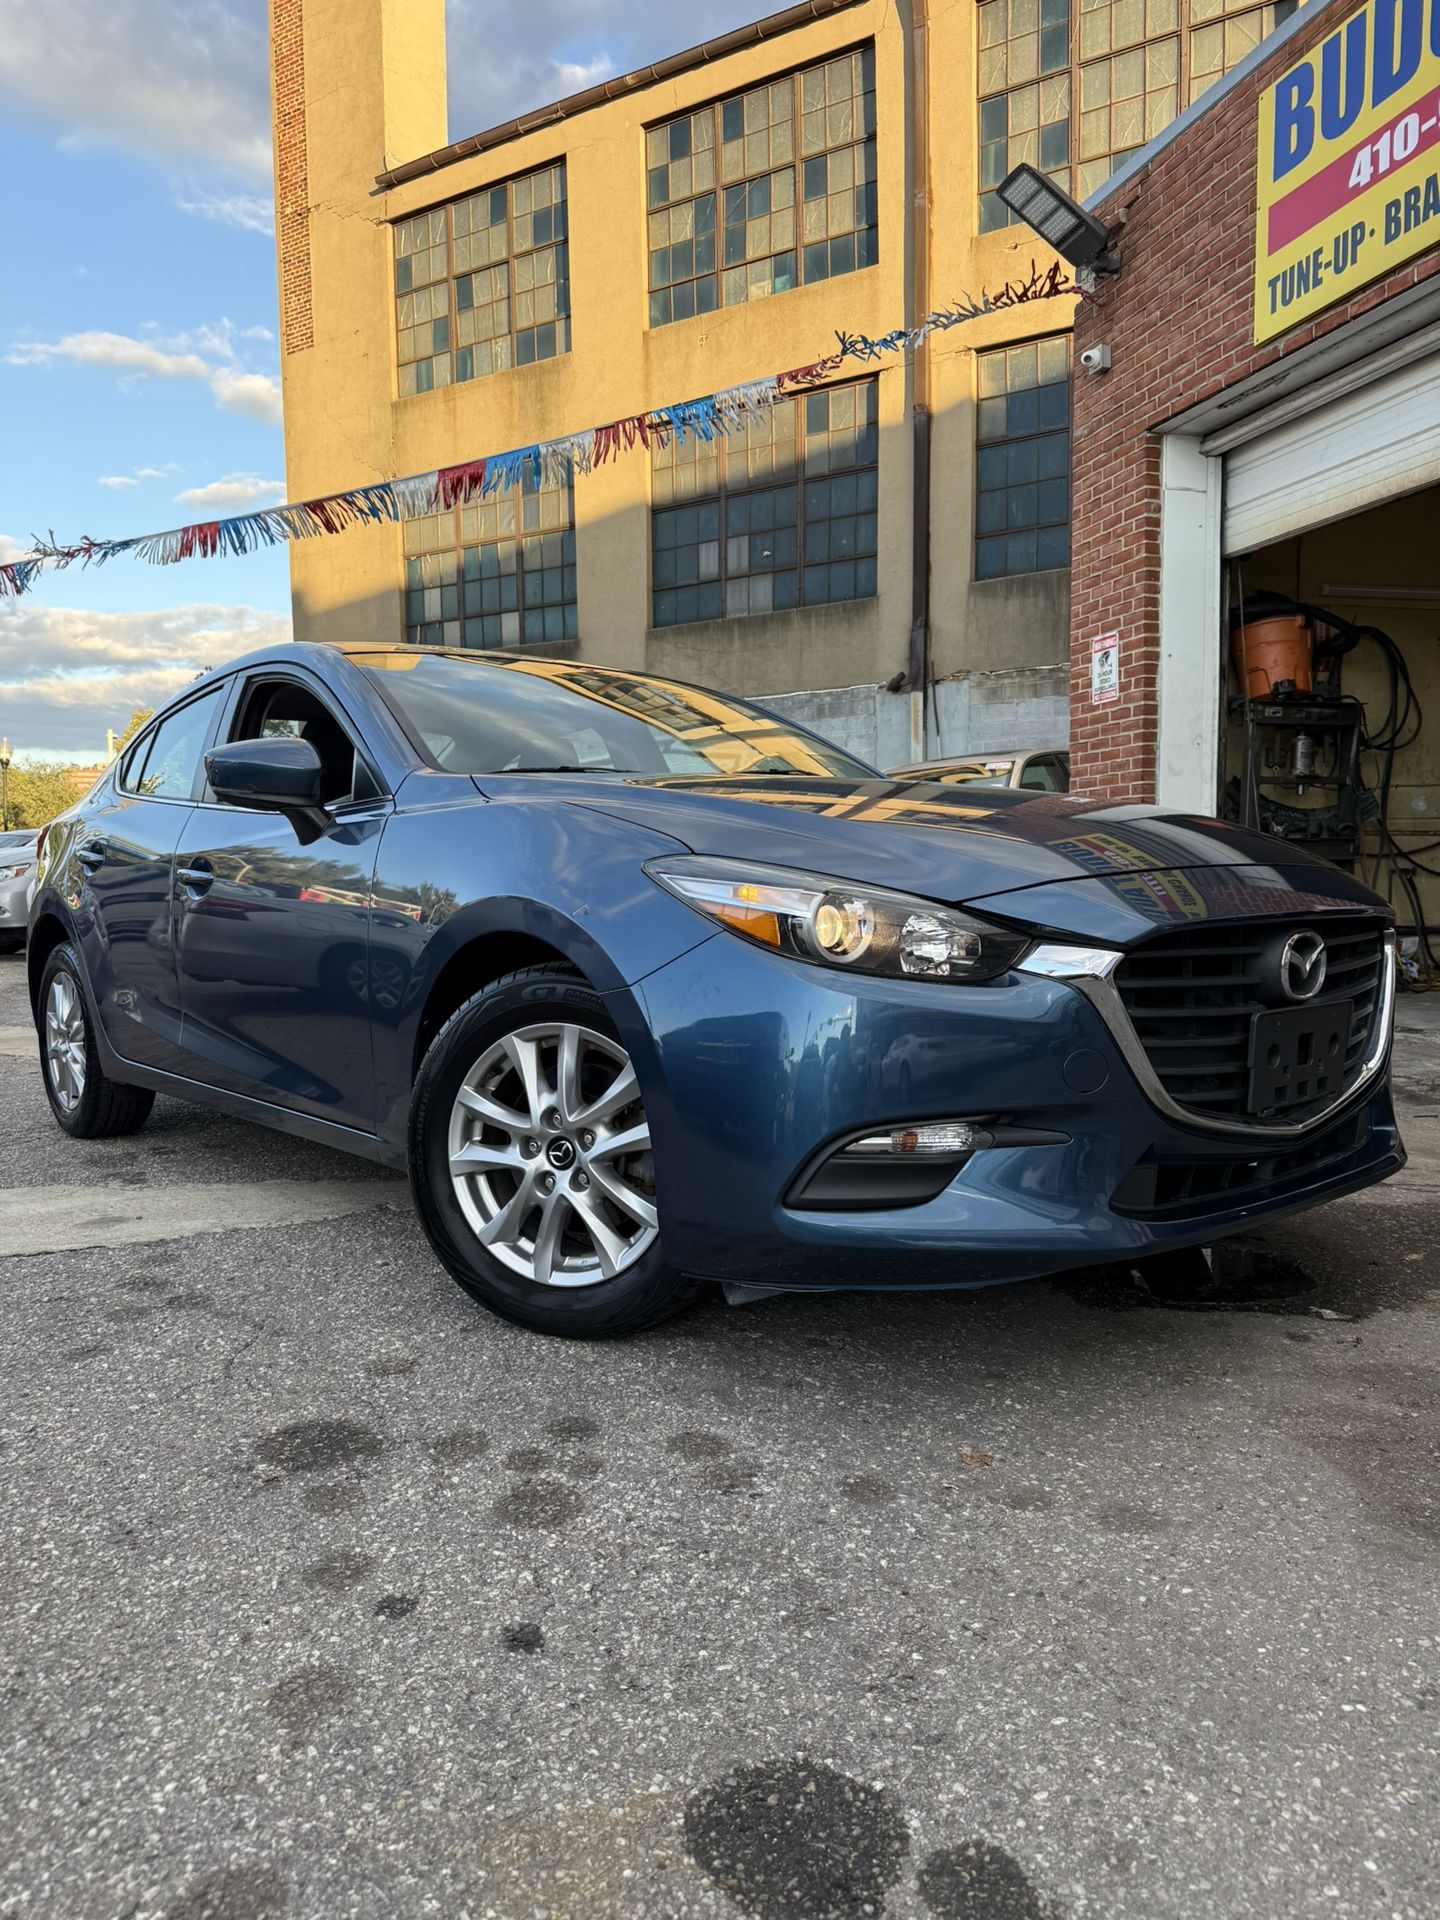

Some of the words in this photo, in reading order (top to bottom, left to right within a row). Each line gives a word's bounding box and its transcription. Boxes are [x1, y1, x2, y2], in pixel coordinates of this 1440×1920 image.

[1273, 0, 1440, 183] BUD
[1348, 112, 1440, 189] 410-
[1268, 220, 1366, 315] TUNE-UP
